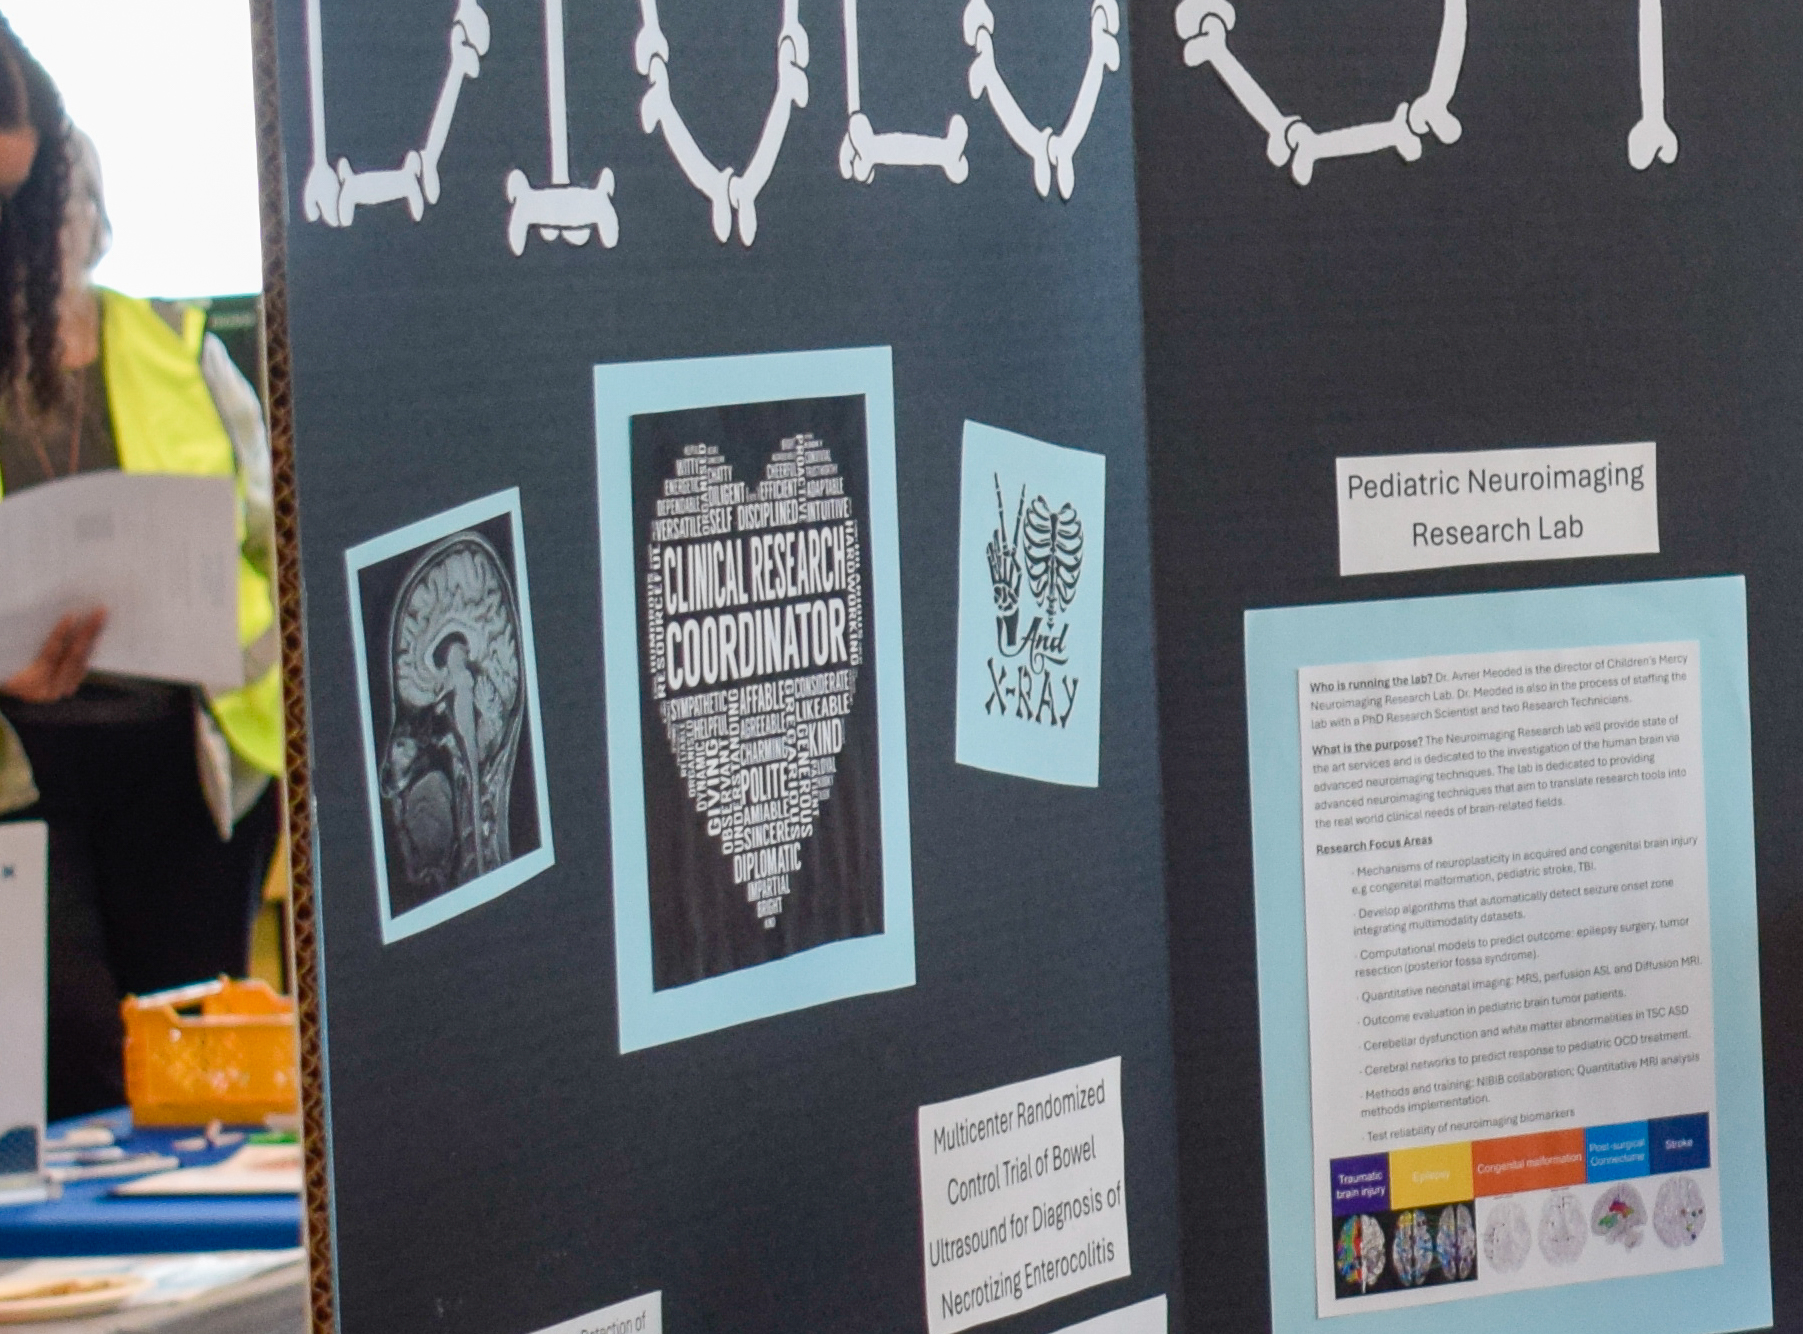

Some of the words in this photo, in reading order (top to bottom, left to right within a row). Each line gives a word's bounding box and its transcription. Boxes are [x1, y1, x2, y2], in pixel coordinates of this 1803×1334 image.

[760, 479, 797, 501] EFFICIENT
[796, 434, 807, 522] PROACTIVE
[807, 477, 844, 497] ADAPTABLE
[1348, 470, 1460, 499] Pediatric
[1469, 462, 1645, 493] Neuroimaging
[657, 496, 700, 516] DEPENDABLE
[708, 481, 745, 507] DILIGENT
[807, 497, 849, 521] INTUITIVE
[655, 515, 700, 541] VERSATILE
[710, 507, 734, 534] SELF
[737, 499, 798, 531] DISCIPLINED
[1413, 518, 1530, 547] Research
[1539, 514, 1583, 540] Lab
[664, 538, 749, 615] CLINICAL
[751, 525, 846, 602] RESEARCH
[666, 598, 848, 690] COORDINATOR
[794, 669, 849, 699] CONSIDERATE
[1310, 681, 1334, 693] Who
[1337, 680, 1345, 690] is
[1349, 677, 1390, 690] running
[1393, 675, 1408, 686] the
[1412, 673, 1433, 685] lab?
[1435, 672, 1448, 683] Dr.
[1452, 671, 1480, 681] Avner
[1483, 666, 1522, 679] Meoded
[1524, 665, 1532, 676] is
[1536, 664, 1551, 675] the
[1554, 661, 1592, 673] director
[1595, 659, 1605, 670] of
[1607, 656, 1656, 669] Children's
[1659, 654, 1688, 666] Mercy
[670, 690, 727, 721] SYMPATHETIC
[740, 680, 785, 716] AFFABLE
[796, 692, 850, 722] LIKEABLE
[985, 657, 1078, 728] X-RAY
[694, 714, 728, 740] HELPFUL
[740, 712, 786, 739] AGREEABLE
[809, 718, 842, 757] KIND
[740, 736, 788, 766] CHARMING
[1312, 743, 1337, 755] What
[1340, 743, 1350, 753] is
[1354, 741, 1371, 752] the
[1375, 736, 1423, 753] purpose?
[728, 688, 744, 853] UNDERSTANDING
[741, 761, 789, 806] POLITE
[796, 723, 813, 838] GENEROUS
[705, 739, 722, 836] GIVING
[718, 737, 734, 855] OBSERVANT
[743, 798, 789, 826] AMIABLE
[744, 820, 790, 850] SINCERE
[1317, 840, 1367, 854] Research
[1370, 839, 1400, 850] Focus
[1403, 836, 1433, 847] Areas
[733, 842, 801, 884] DIPLOMATIC
[748, 874, 790, 902] IMPARTIAL
[934, 1110, 1013, 1154] Multicenter
[1018, 1078, 1105, 1129] Randomized
[1665, 1138, 1694, 1150] Stroke
[948, 1164, 1000, 1206] Control
[1003, 1154, 1032, 1188] Trial
[1037, 1148, 1049, 1177] of
[1053, 1133, 1096, 1171] Bowel
[1339, 1170, 1383, 1185] Traumatic
[1477, 1158, 1525, 1175] Congenital
[1527, 1152, 1582, 1169] malformation
[1336, 1188, 1359, 1200] brain
[1362, 1185, 1386, 1198] injury
[930, 1217, 1007, 1268] Ultrasound
[1011, 1214, 1030, 1241] for
[1033, 1188, 1102, 1233] Diagnosis
[1107, 1178, 1121, 1208] of
[942, 1273, 1021, 1320] Necrotizing
[1025, 1238, 1114, 1291] Enterocolitis
[636, 1310, 647, 1332] of
